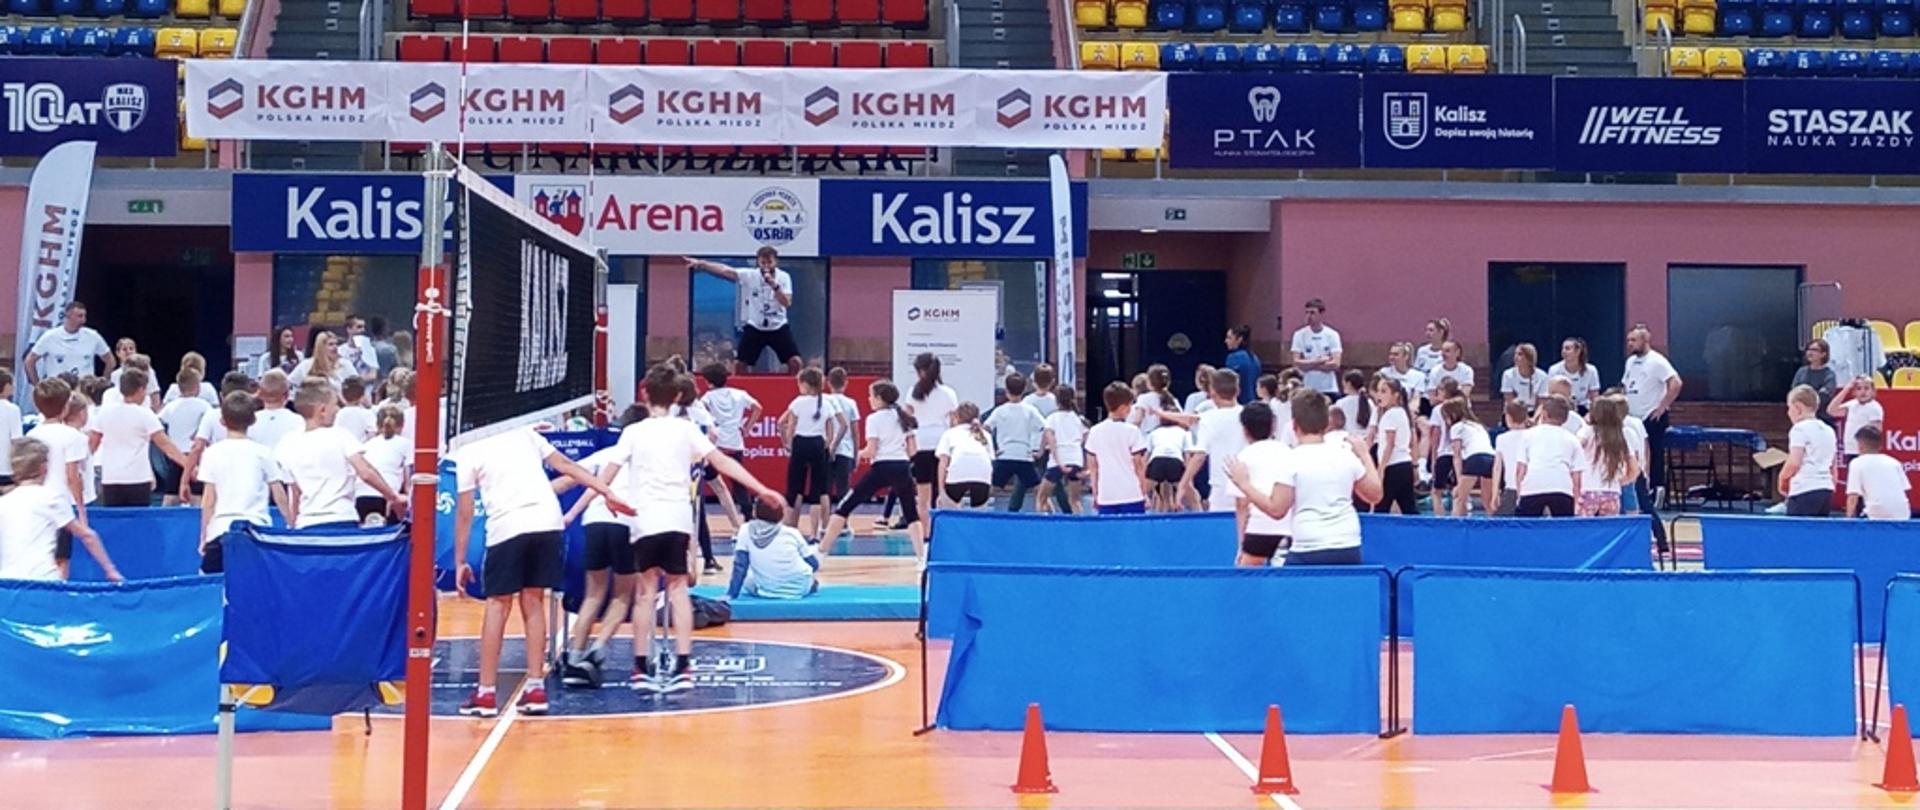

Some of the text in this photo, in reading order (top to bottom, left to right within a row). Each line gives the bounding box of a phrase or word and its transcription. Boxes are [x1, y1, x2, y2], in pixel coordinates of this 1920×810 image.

[257, 84, 366, 110] KGHM
[460, 88, 565, 112] KGHM
[657, 90, 762, 115] KGHM
[853, 92, 955, 117] KGHM
[3, 82, 64, 132] 10
[1044, 95, 1147, 119] KGHM
[1435, 105, 1487, 122] Kalisz
[1611, 106, 1690, 125] WELL
[257, 114, 312, 122] POLSKA
[460, 117, 513, 125] OLSKA
[657, 118, 711, 127] POLSKA
[852, 121, 905, 129] POLSKA
[1044, 123, 1097, 131] POLSKA
[1768, 109, 1913, 134] STASZAK
[1214, 129, 1315, 148] PTAK
[1435, 127, 1467, 139] Dopisz
[1469, 128, 1497, 139] swoją
[1600, 125, 1722, 144] FITNESS
[1767, 135, 1914, 147] NAUKA JAZDY
[596, 194, 724, 232] Arena
[872, 191, 1036, 244] Kalisz
[32, 204, 68, 329] KGHM
[923, 308, 960, 318] KGHM
[742, 446, 774, 459] opisz
